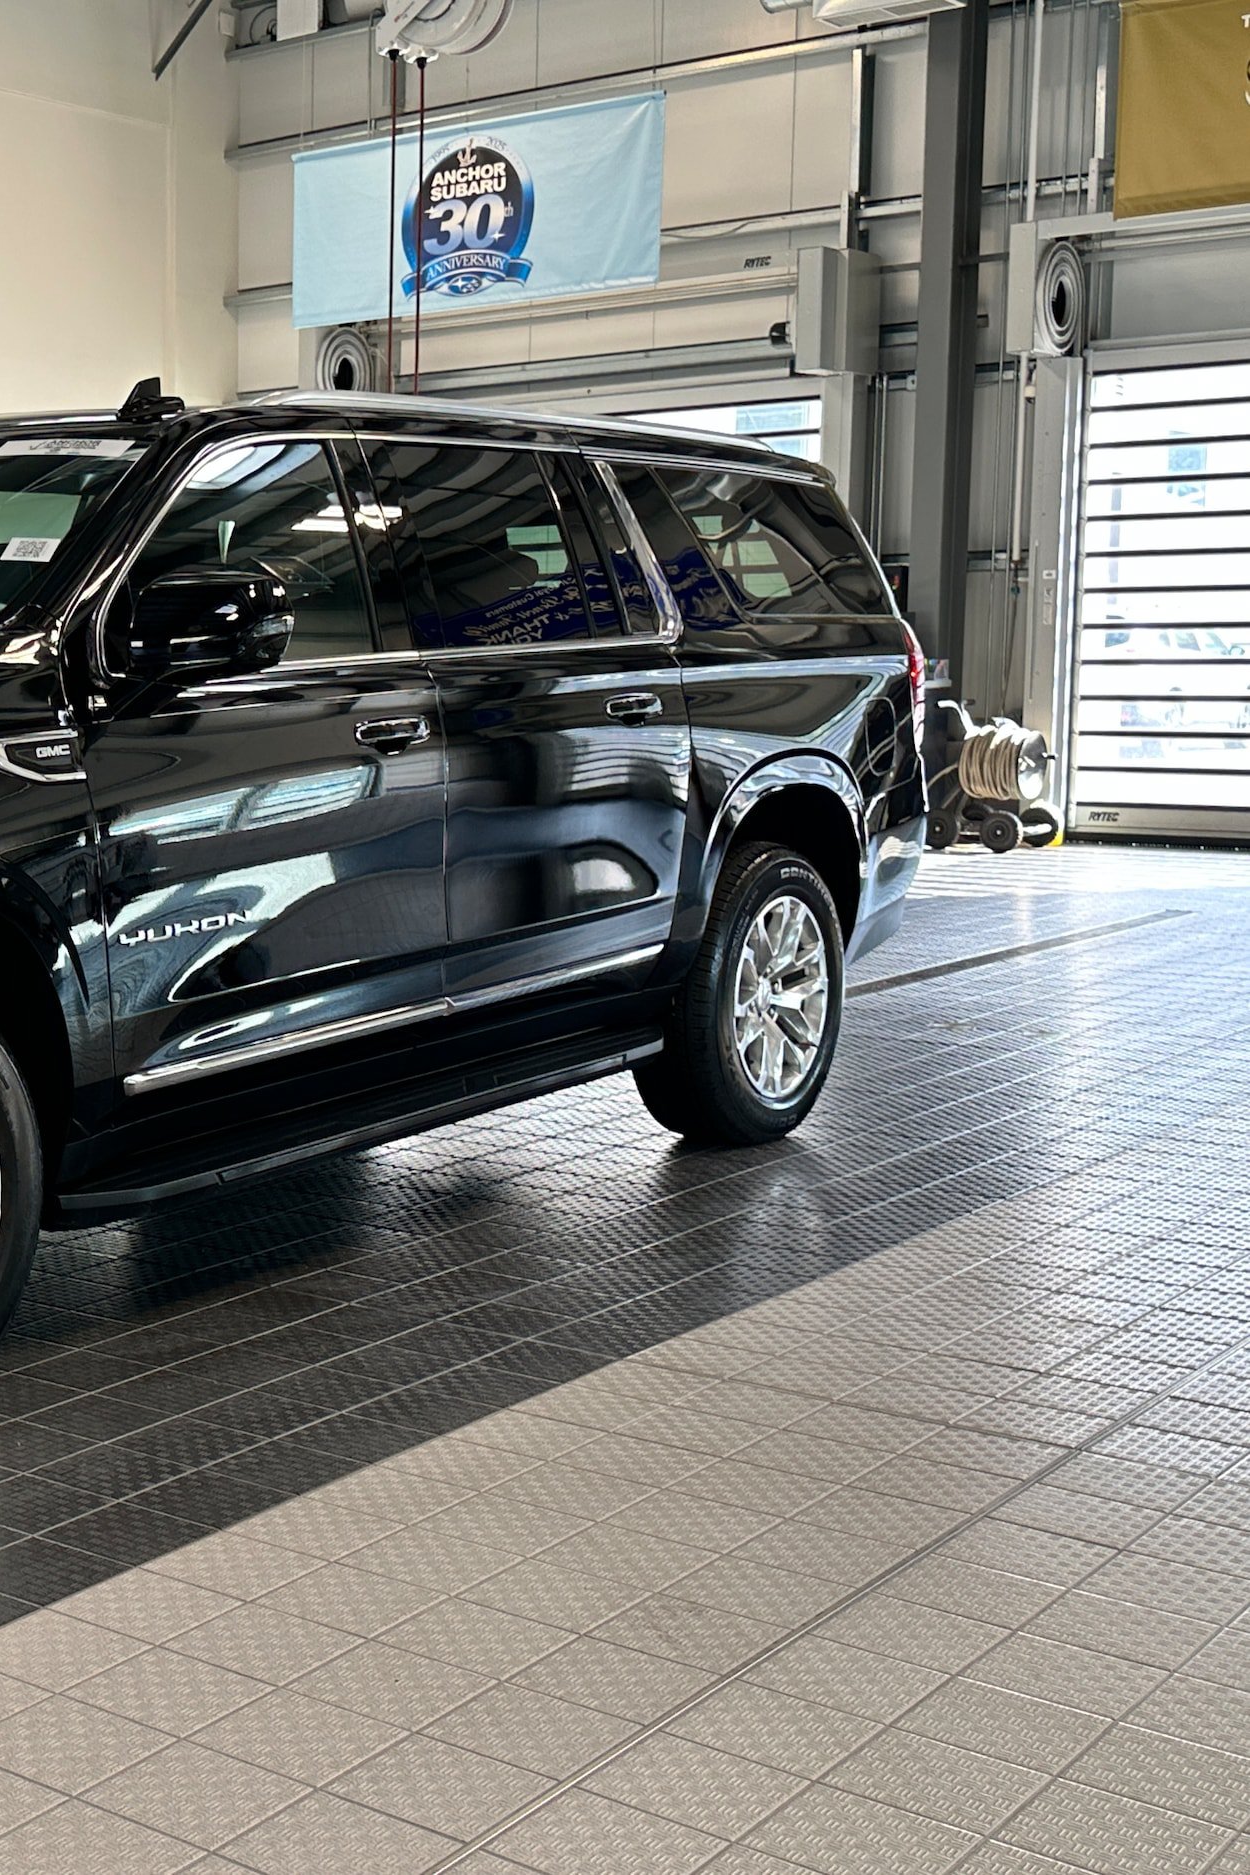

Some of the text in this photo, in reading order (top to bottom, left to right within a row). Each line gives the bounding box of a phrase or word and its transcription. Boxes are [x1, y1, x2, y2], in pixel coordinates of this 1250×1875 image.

[431, 162, 506, 187] ANCHOR
[430, 177, 507, 202] SUBARU
[425, 254, 506, 281] ANNIVERSARY
[743, 255, 771, 269] RYTEC
[35, 744, 71, 759] GMC
[1088, 811, 1120, 822] RYTEC
[118, 909, 253, 947] YUKON
